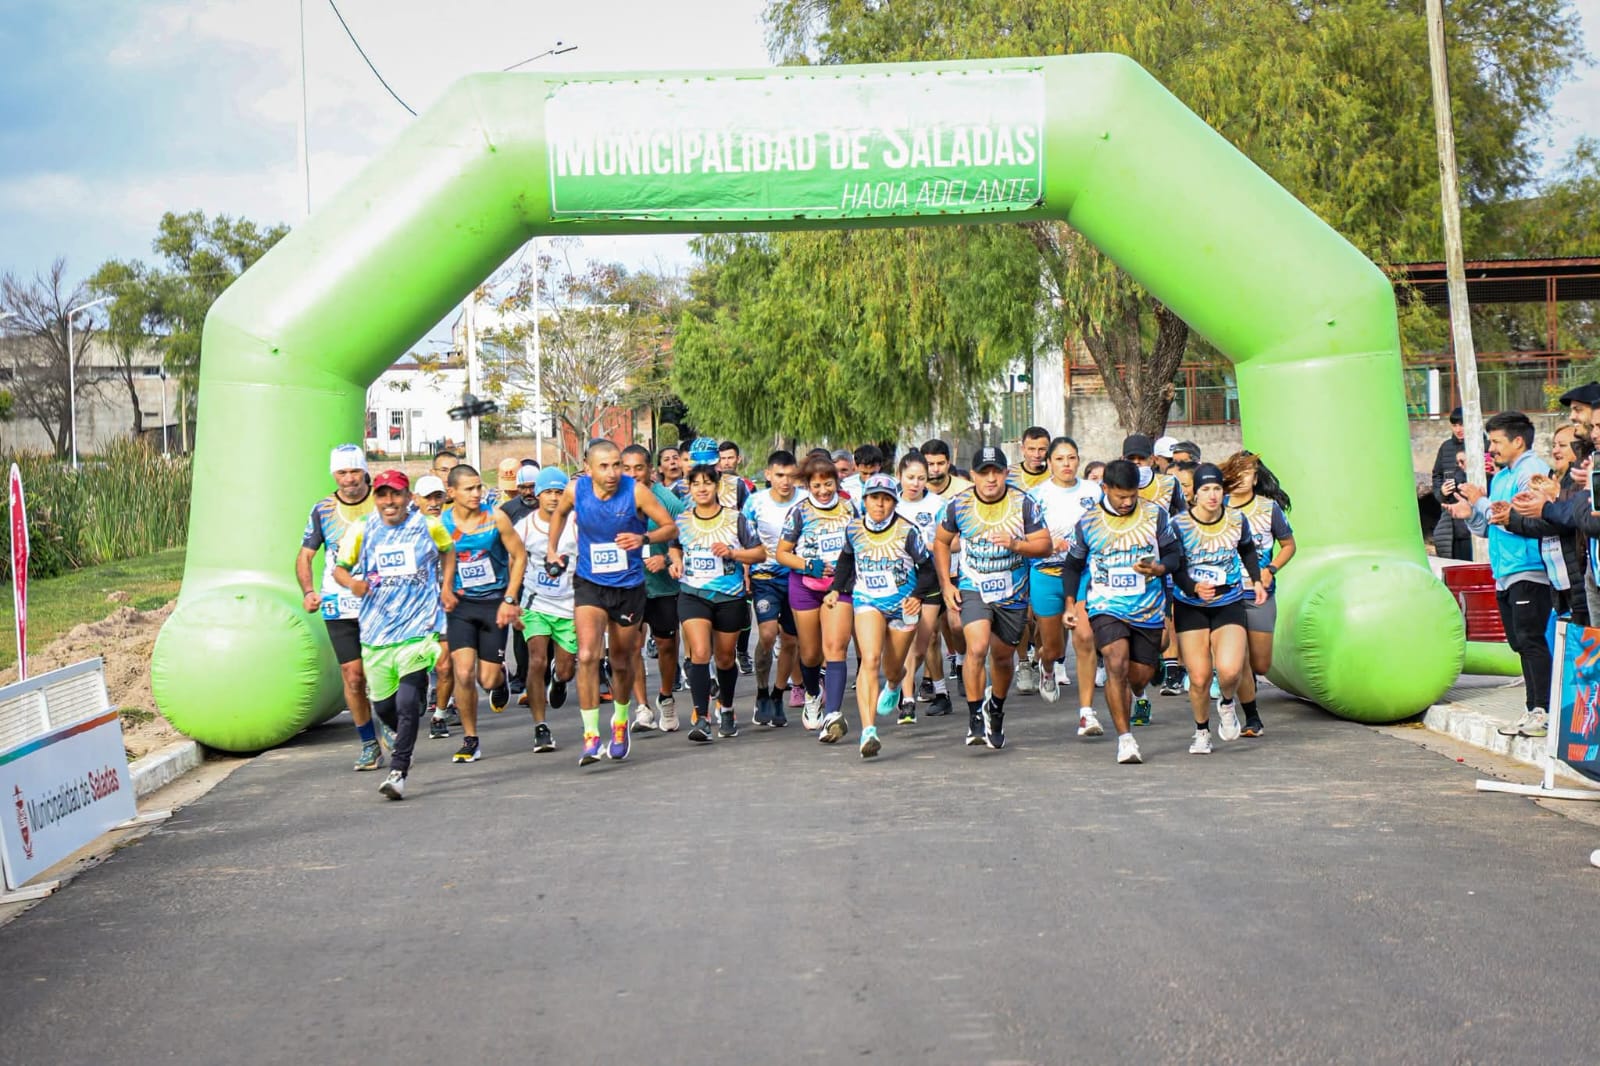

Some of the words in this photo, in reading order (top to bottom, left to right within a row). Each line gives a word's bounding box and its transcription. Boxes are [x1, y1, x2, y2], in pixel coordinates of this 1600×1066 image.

[557, 128, 816, 177] MUNICIPALIDAD
[829, 130, 870, 170] DE
[882, 120, 1036, 169] SALADAS
[842, 182, 909, 209] HACIA
[915, 178, 1036, 207] ADELANTE
[823, 538, 842, 550] 098
[380, 553, 404, 566] 049
[594, 552, 617, 563] 093
[694, 559, 714, 569] 099
[462, 567, 486, 577] 092
[865, 576, 887, 588] 100
[983, 579, 1005, 592] 090
[1112, 575, 1135, 587] 063
[27, 779, 80, 833] Municipalidad
[88, 765, 119, 802] Saladas
